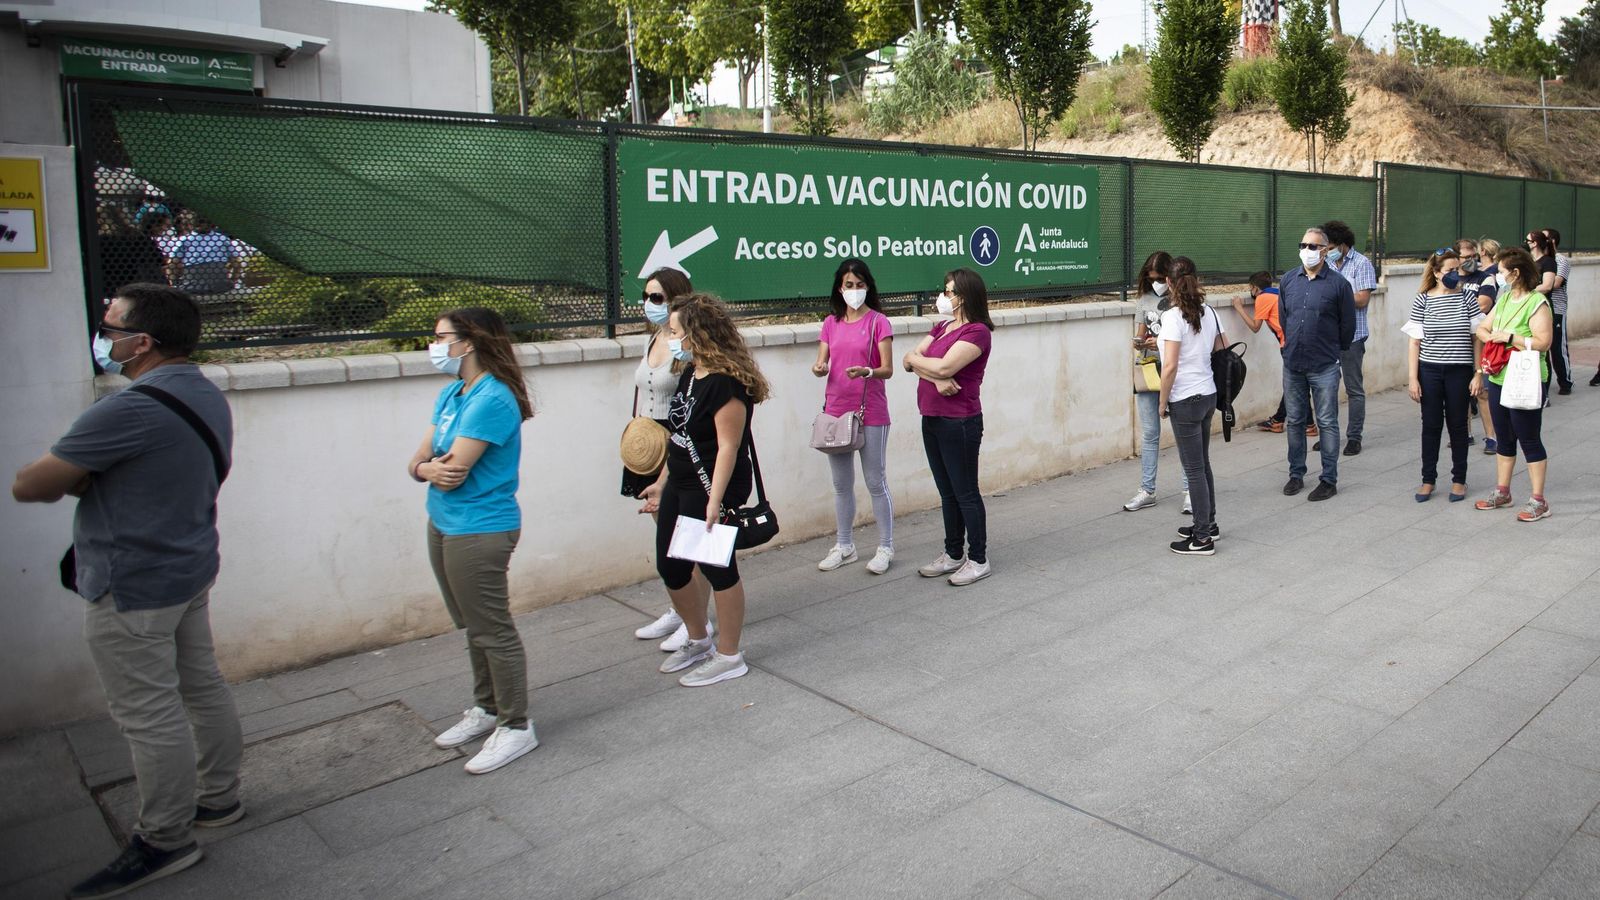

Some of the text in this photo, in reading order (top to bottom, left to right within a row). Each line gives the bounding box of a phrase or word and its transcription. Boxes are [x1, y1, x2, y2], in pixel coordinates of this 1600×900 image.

[63, 44, 200, 65] VACUNACIÓN COVID
[101, 60, 168, 74] ENTRADA
[647, 167, 1087, 210] ENTRADA VACUNACIÓN COVID
[1039, 226, 1062, 237] Junta
[734, 234, 965, 260] Acceso Solo Peatonal
[1039, 237, 1089, 250] de Andalucía
